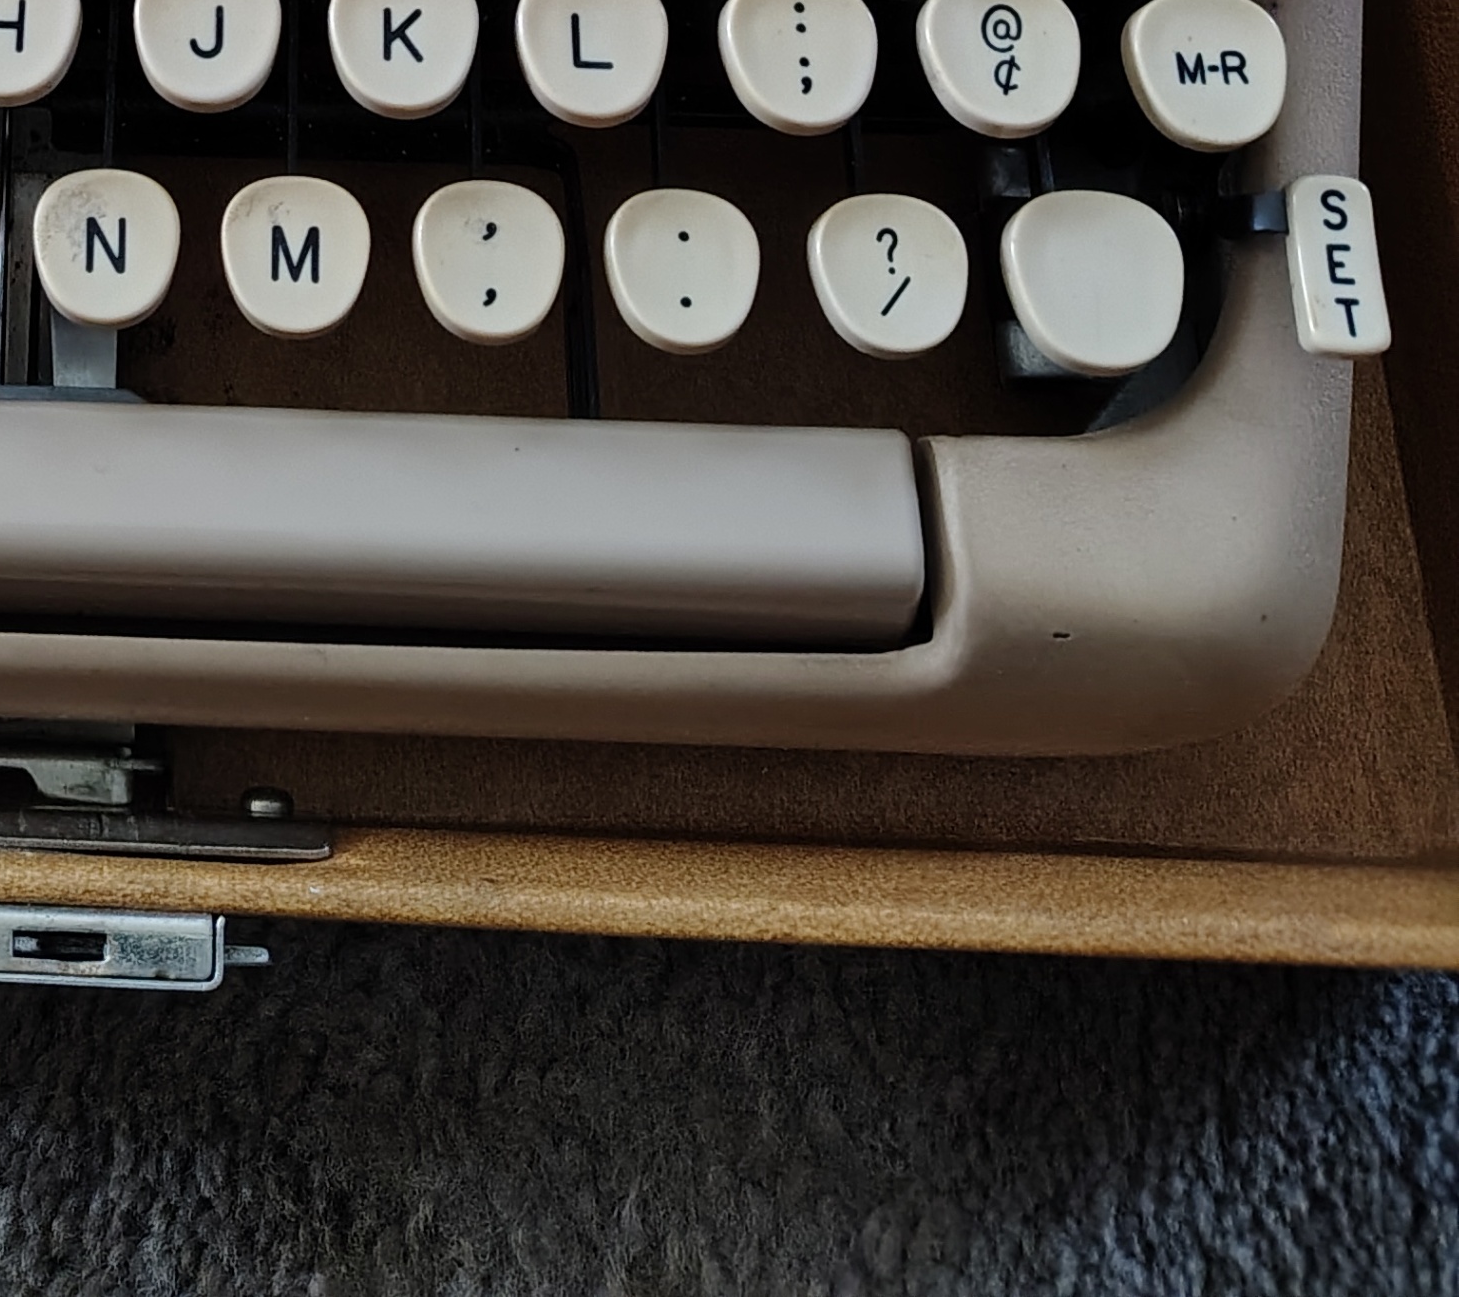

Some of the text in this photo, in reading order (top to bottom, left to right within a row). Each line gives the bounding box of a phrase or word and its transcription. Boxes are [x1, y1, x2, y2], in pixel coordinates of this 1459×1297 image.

[188, 4, 225, 60] J
[382, 6, 425, 64] K
[569, 11, 615, 71] L
[979, 2, 1024, 53] @
[992, 54, 1022, 97] ¢
[1174, 49, 1250, 86] M-R
[84, 215, 128, 275] N
[270, 223, 321, 285] M
[875, 226, 899, 276] ?
[1319, 188, 1361, 339] SET
